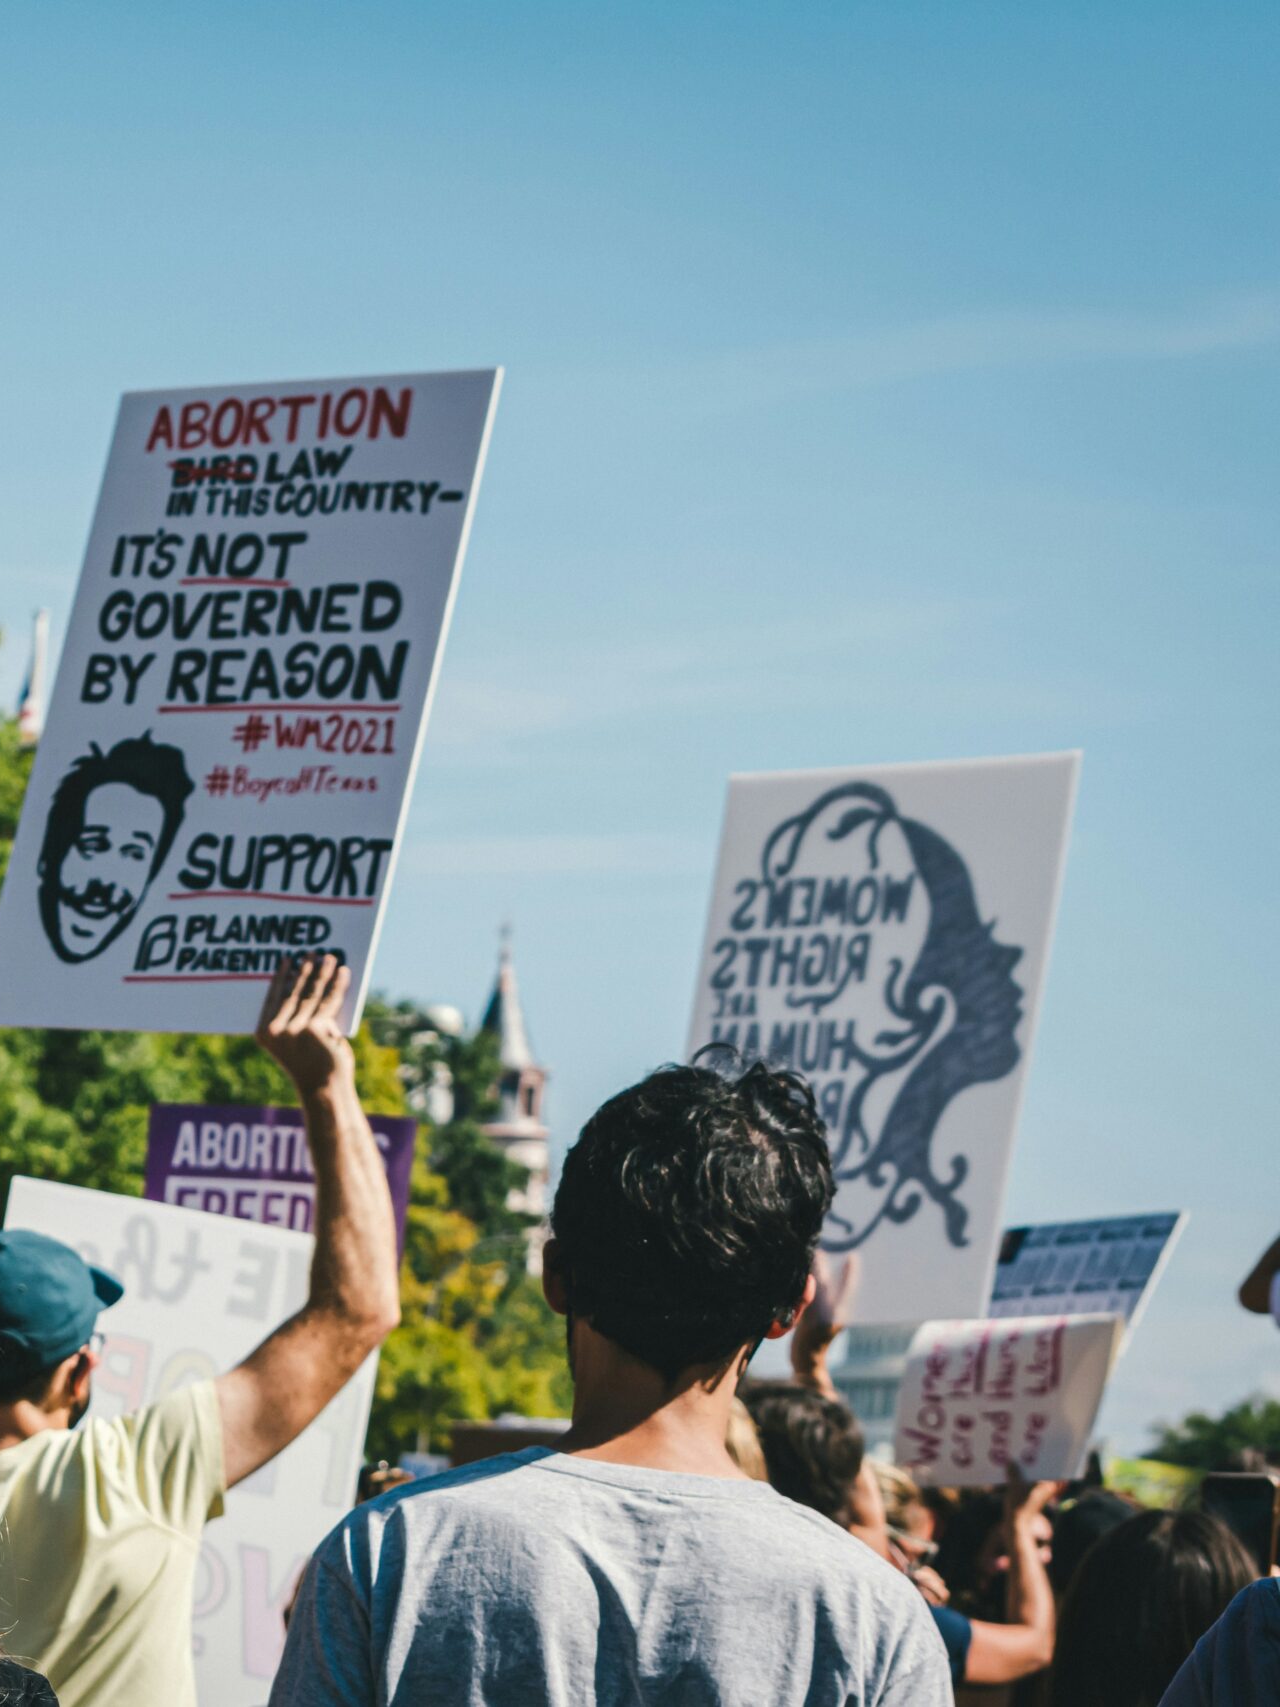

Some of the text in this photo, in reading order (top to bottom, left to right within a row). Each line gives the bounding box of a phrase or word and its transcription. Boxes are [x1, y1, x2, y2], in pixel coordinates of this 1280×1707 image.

[144, 386, 413, 453] ABORTION
[264, 445, 354, 483] LAW
[166, 489, 198, 517] IN
[206, 488, 270, 517] THIS
[186, 532, 308, 580] NOT
[98, 580, 403, 643] GOVERNED
[80, 640, 410, 705] BY REASON
[232, 714, 396, 755] #WM2021
[177, 833, 393, 897] SUPPORT
[184, 914, 332, 944] PLANNED
